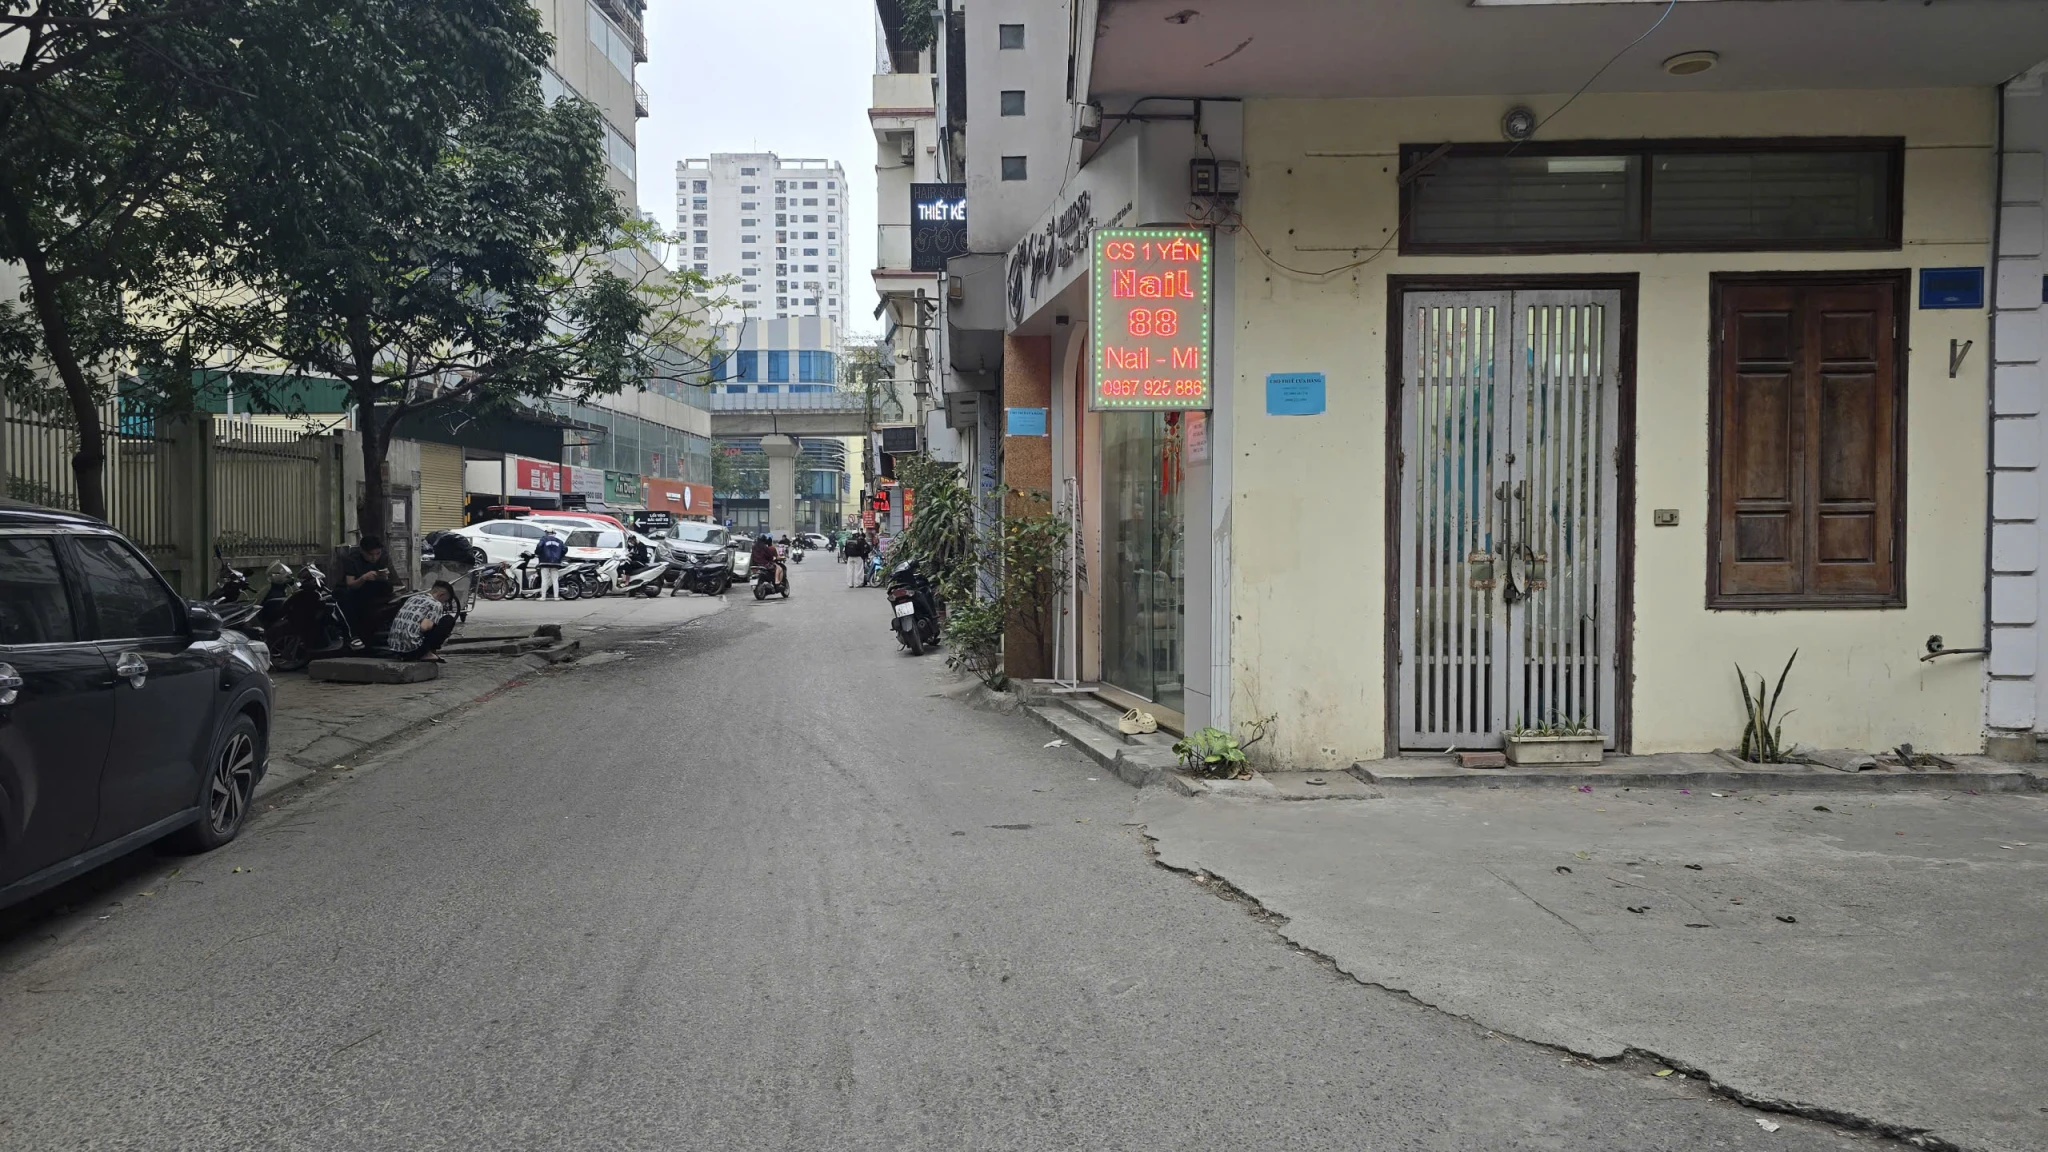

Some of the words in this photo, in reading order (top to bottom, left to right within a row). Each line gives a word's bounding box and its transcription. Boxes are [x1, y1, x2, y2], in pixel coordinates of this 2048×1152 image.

[914, 186, 936, 199] HAIR
[939, 186, 966, 199] SALO
[918, 199, 948, 220] THIẾT
[950, 199, 966, 220] KẾ
[1107, 242, 1135, 260] CS
[1142, 242, 1150, 260] 1
[1112, 269, 1194, 298] Nail
[1129, 308, 1179, 337] 88
[1106, 347, 1149, 369] Nail
[1173, 347, 1198, 369] Mi
[1103, 379, 1140, 396] 0967
[1143, 379, 1171, 396] 925
[1175, 379, 1202, 396] 886
